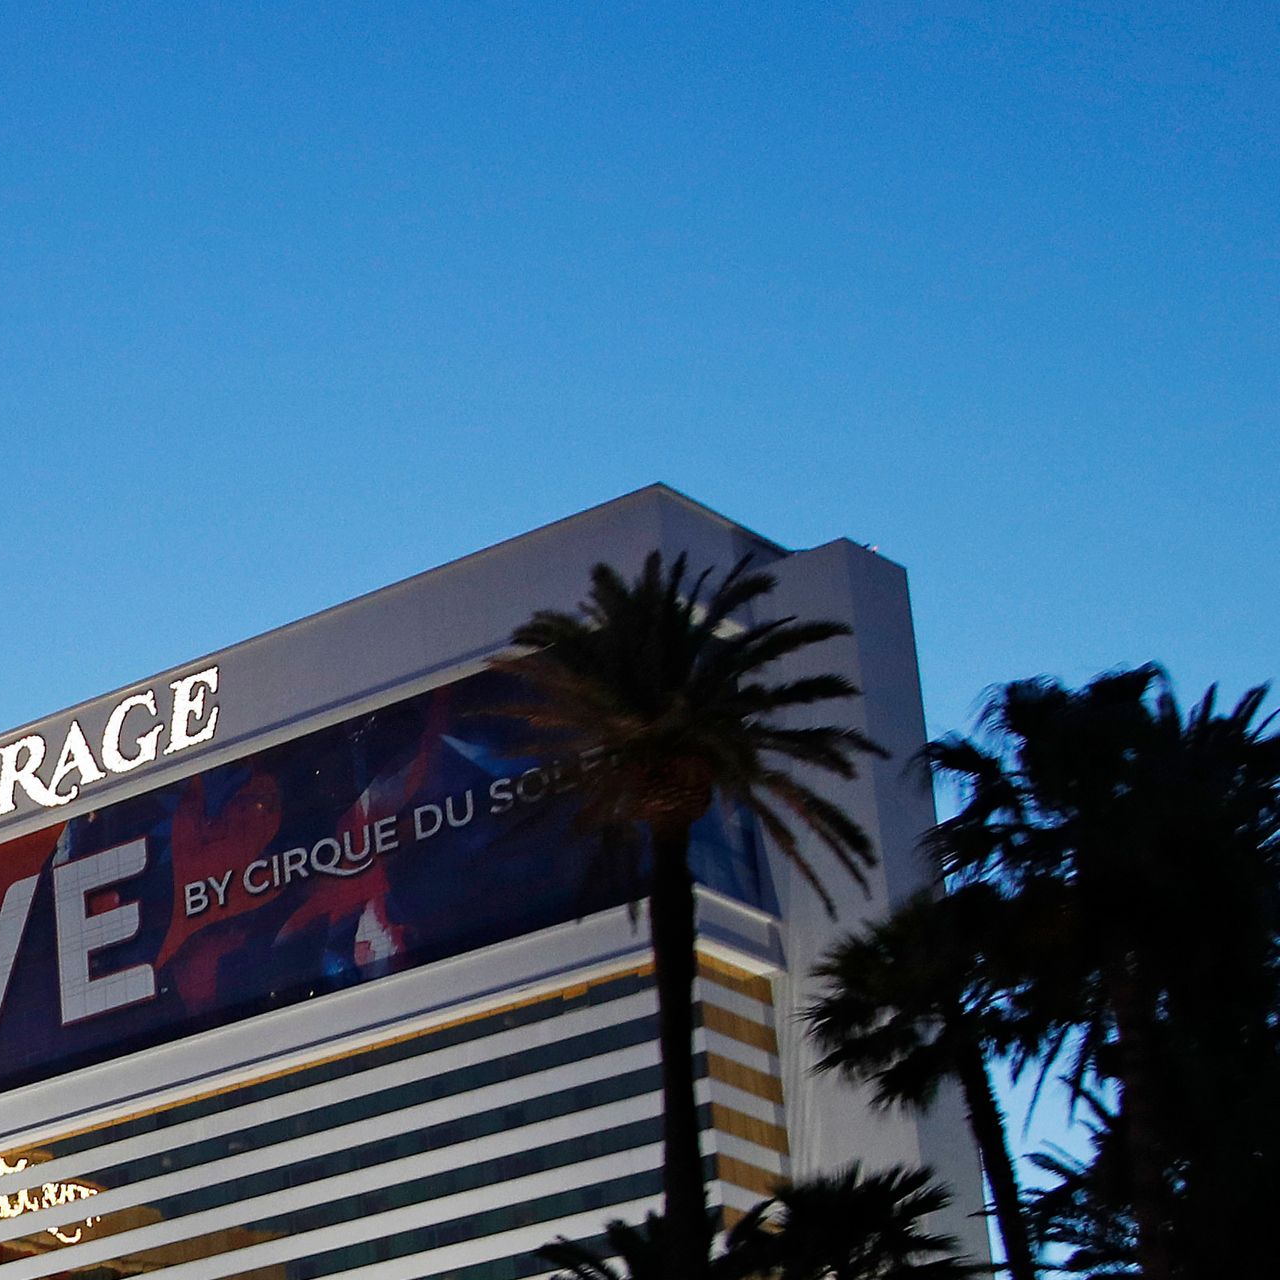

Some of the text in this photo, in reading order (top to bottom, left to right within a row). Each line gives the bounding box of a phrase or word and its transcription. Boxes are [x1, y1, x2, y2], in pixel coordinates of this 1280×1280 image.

[183, 869, 233, 917] BY
[242, 814, 400, 894] CIRQUE
[413, 788, 475, 841] DU
